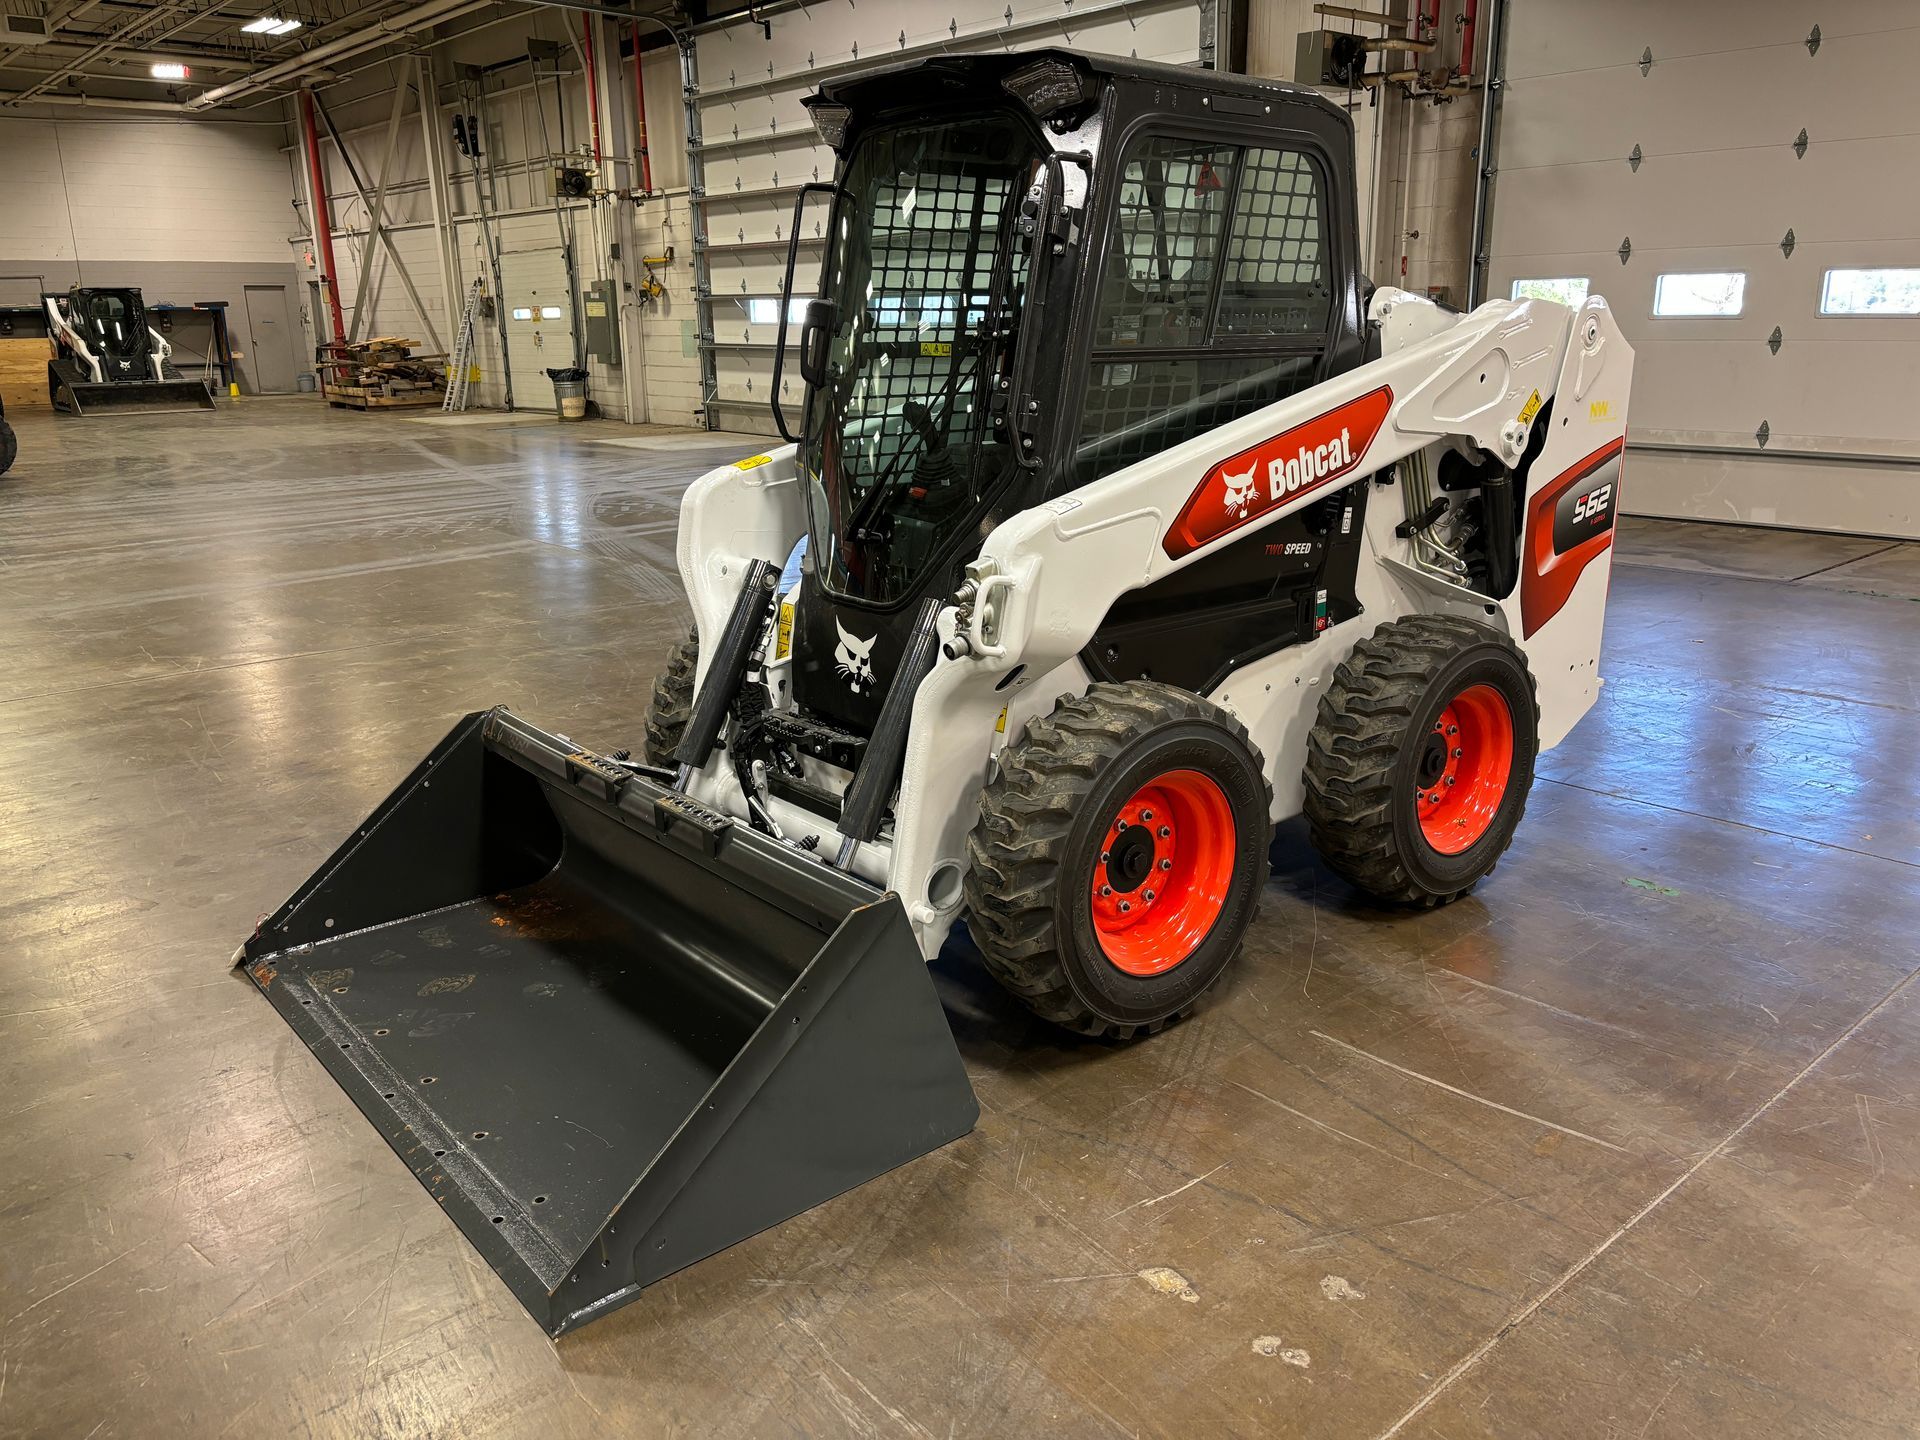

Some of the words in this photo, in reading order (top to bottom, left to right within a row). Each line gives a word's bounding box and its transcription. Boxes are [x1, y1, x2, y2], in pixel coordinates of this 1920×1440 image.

[1268, 427, 1351, 501] Bobcat
[1572, 483, 1612, 524] S62
[1265, 543, 1284, 556] TWO
[1284, 542, 1312, 555] SPEED
